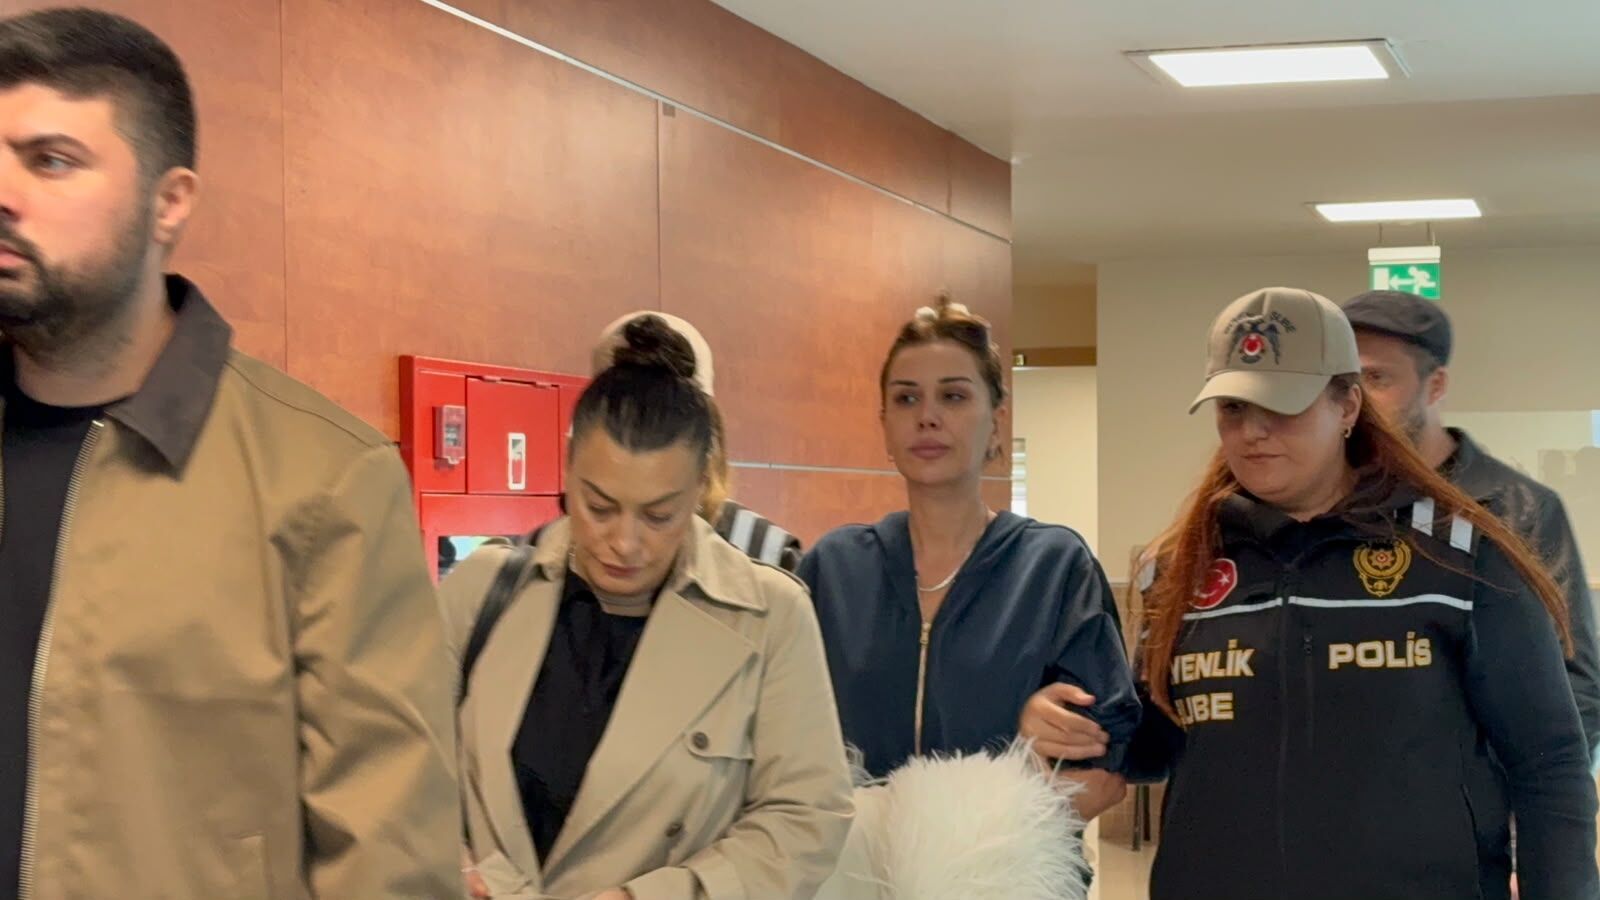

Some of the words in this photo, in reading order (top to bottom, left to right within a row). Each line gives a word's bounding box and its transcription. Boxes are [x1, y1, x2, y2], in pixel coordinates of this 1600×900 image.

[1171, 639, 1255, 685] VENLİK
[1328, 631, 1432, 670] POLİS
[1174, 692, 1234, 725] UBE
